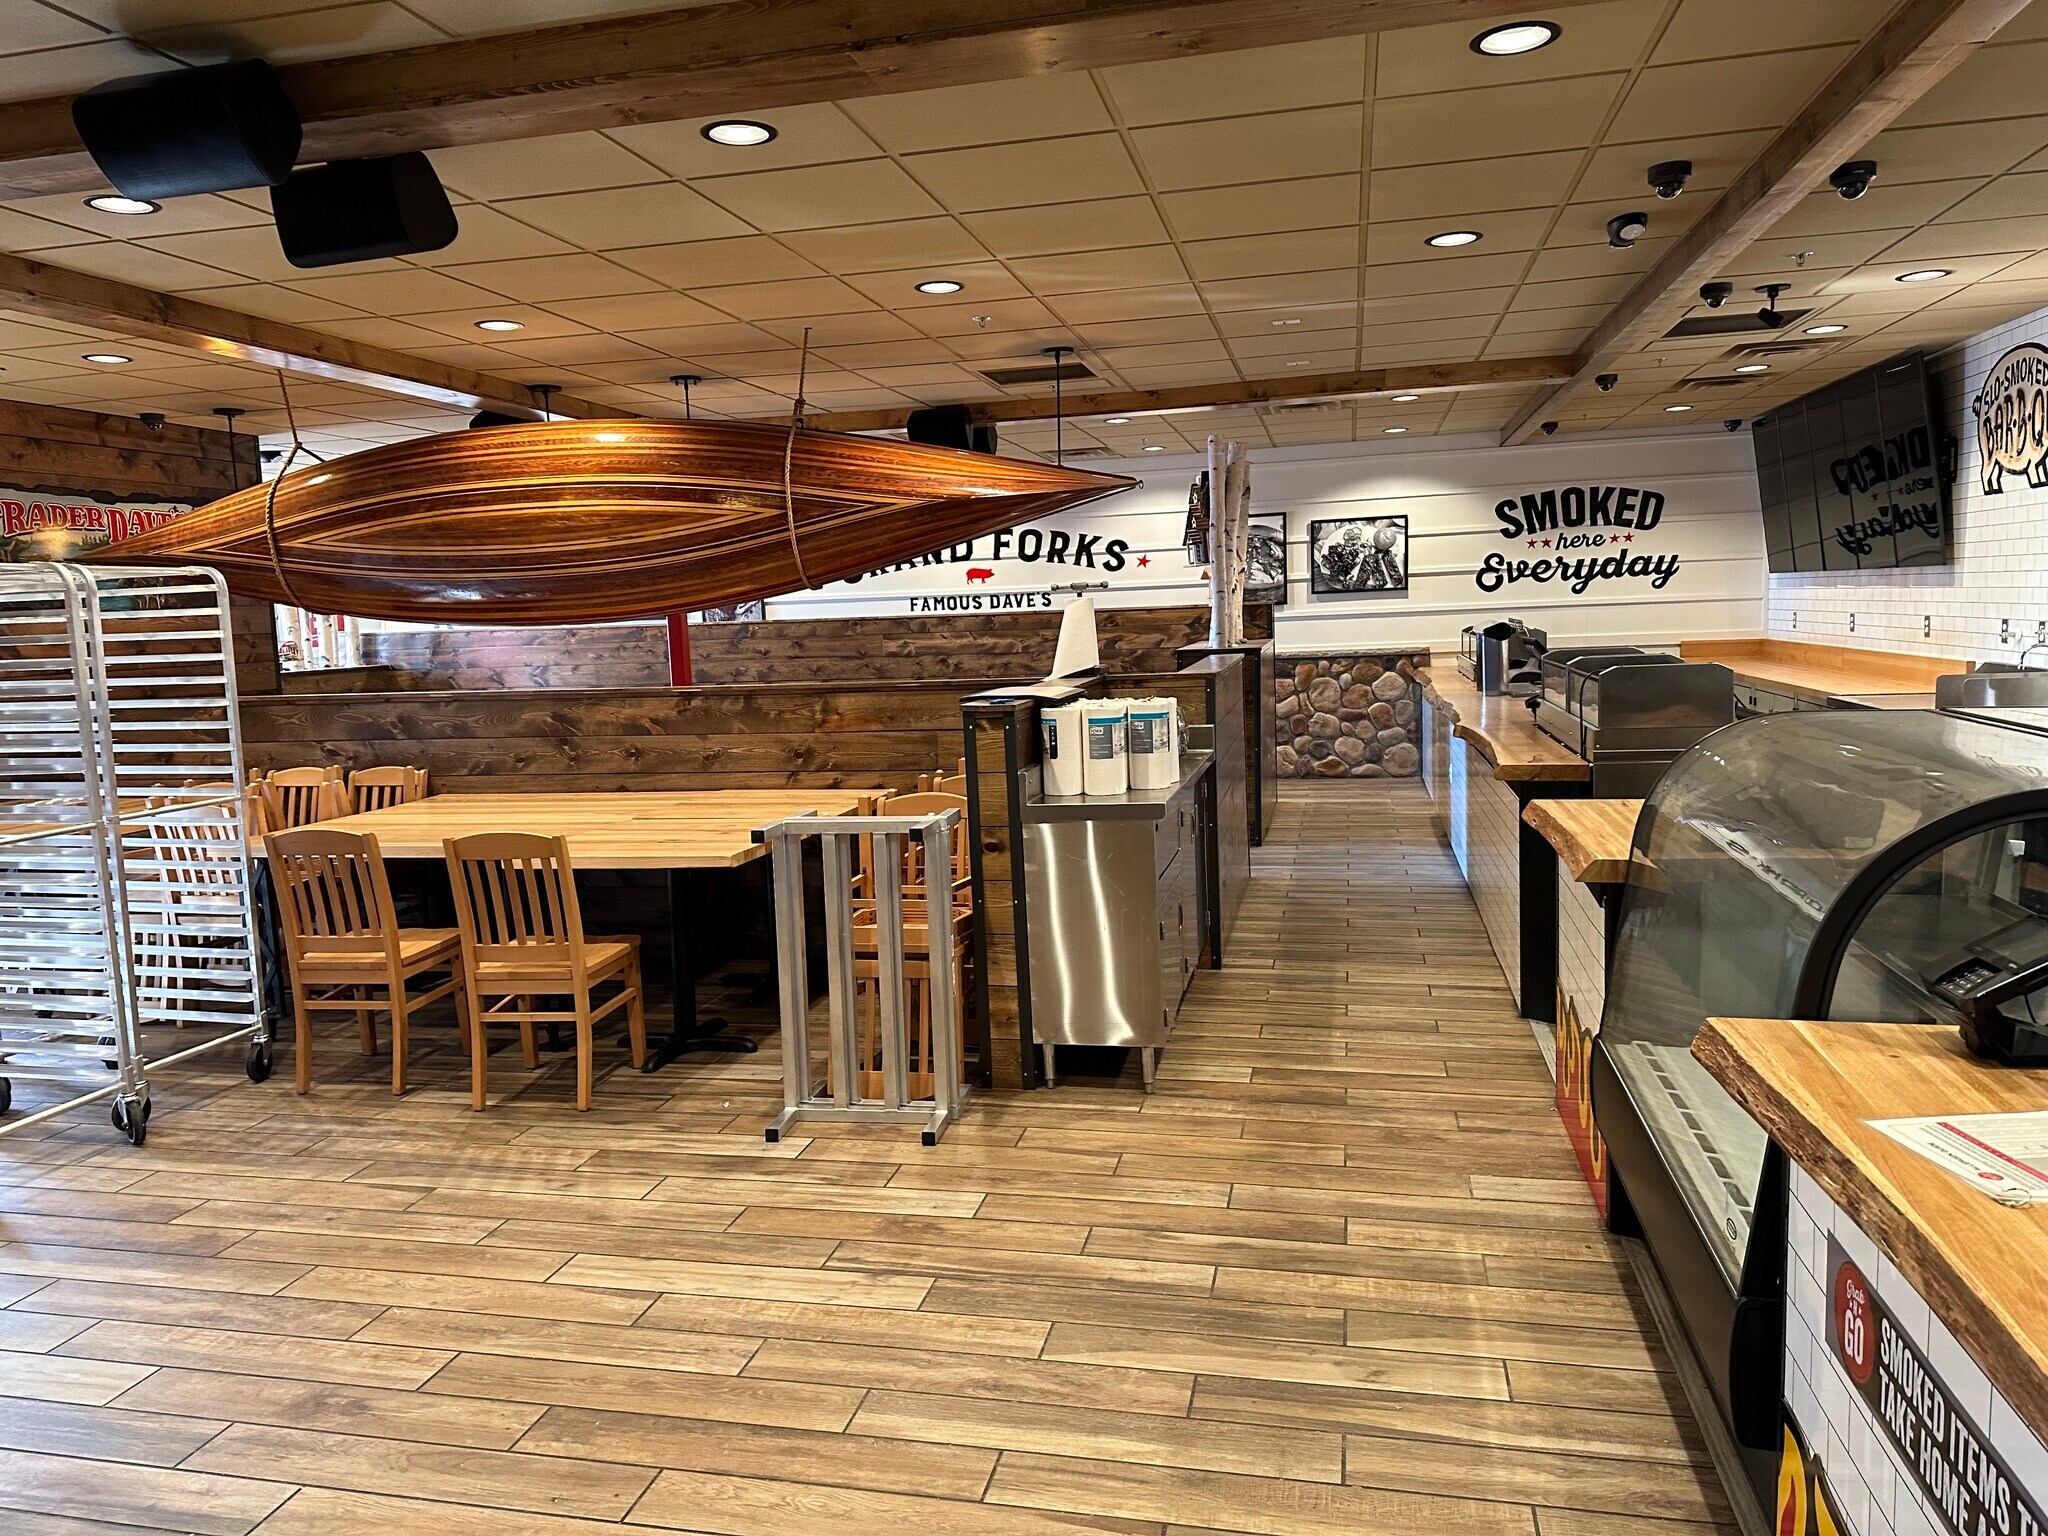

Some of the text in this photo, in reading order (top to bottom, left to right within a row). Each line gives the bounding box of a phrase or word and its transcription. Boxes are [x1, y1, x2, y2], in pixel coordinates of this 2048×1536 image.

[0, 499, 107, 538] RADER
[1494, 485, 1666, 540] SMOKED
[992, 527, 1130, 573] FORKS
[1554, 532, 1607, 551] here
[1475, 548, 1680, 595] Everyday
[909, 591, 1052, 613] FAMOUS DAVE'S
[1846, 1278, 1866, 1304] Grab
[1844, 1308, 1865, 1366] GO
[1880, 1317, 2011, 1536] SMOKED ITEMS
[1878, 1365, 1972, 1536] TAKE HOME
